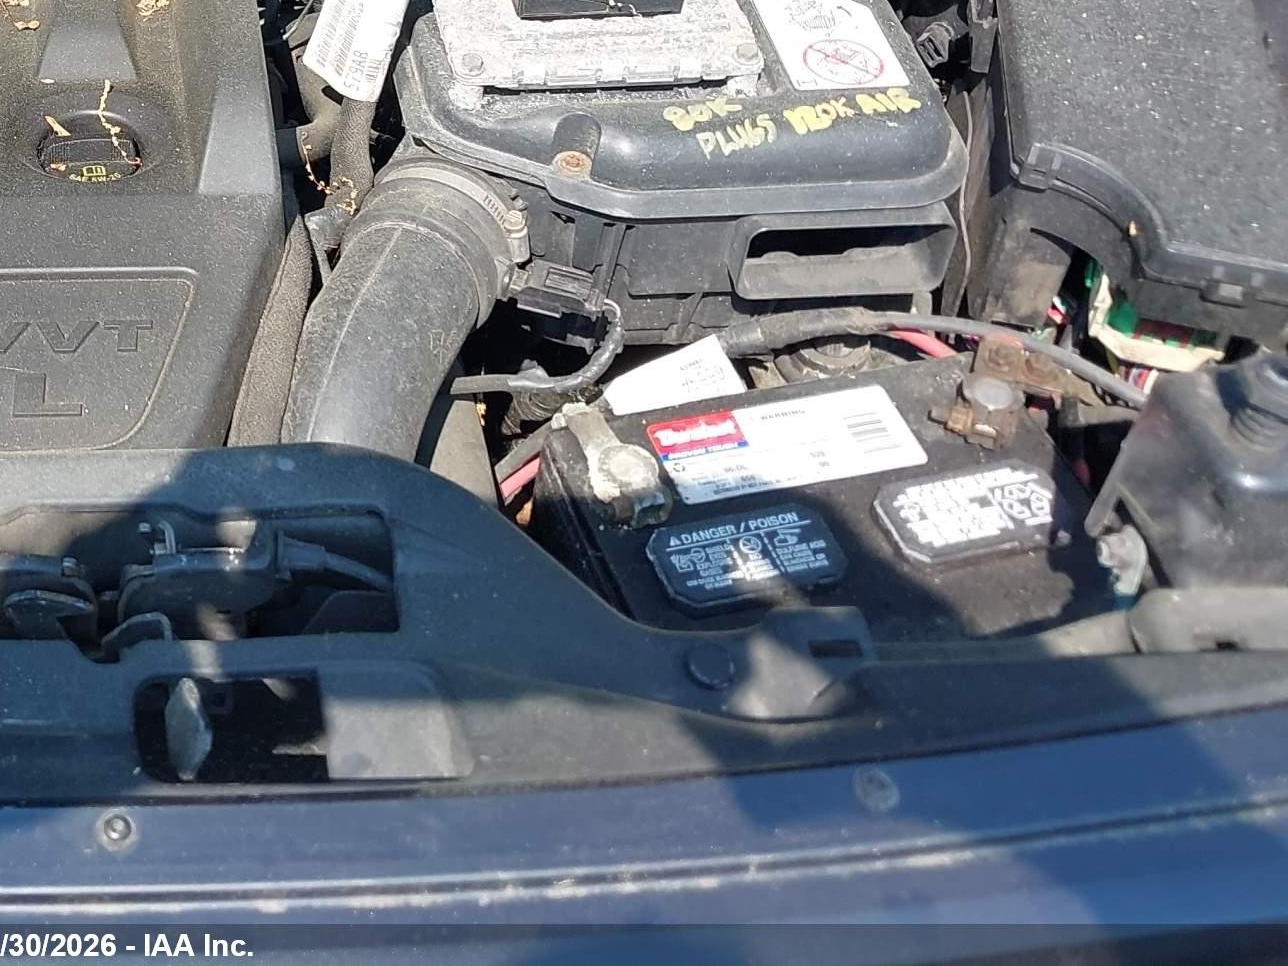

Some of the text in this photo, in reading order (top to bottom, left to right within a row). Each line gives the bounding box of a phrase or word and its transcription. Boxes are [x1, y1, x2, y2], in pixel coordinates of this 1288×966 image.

[855, 87, 921, 114] AIR
[696, 113, 778, 161] PLUGS
[680, 523, 737, 544] DANGER
[748, 512, 799, 530] POISON
